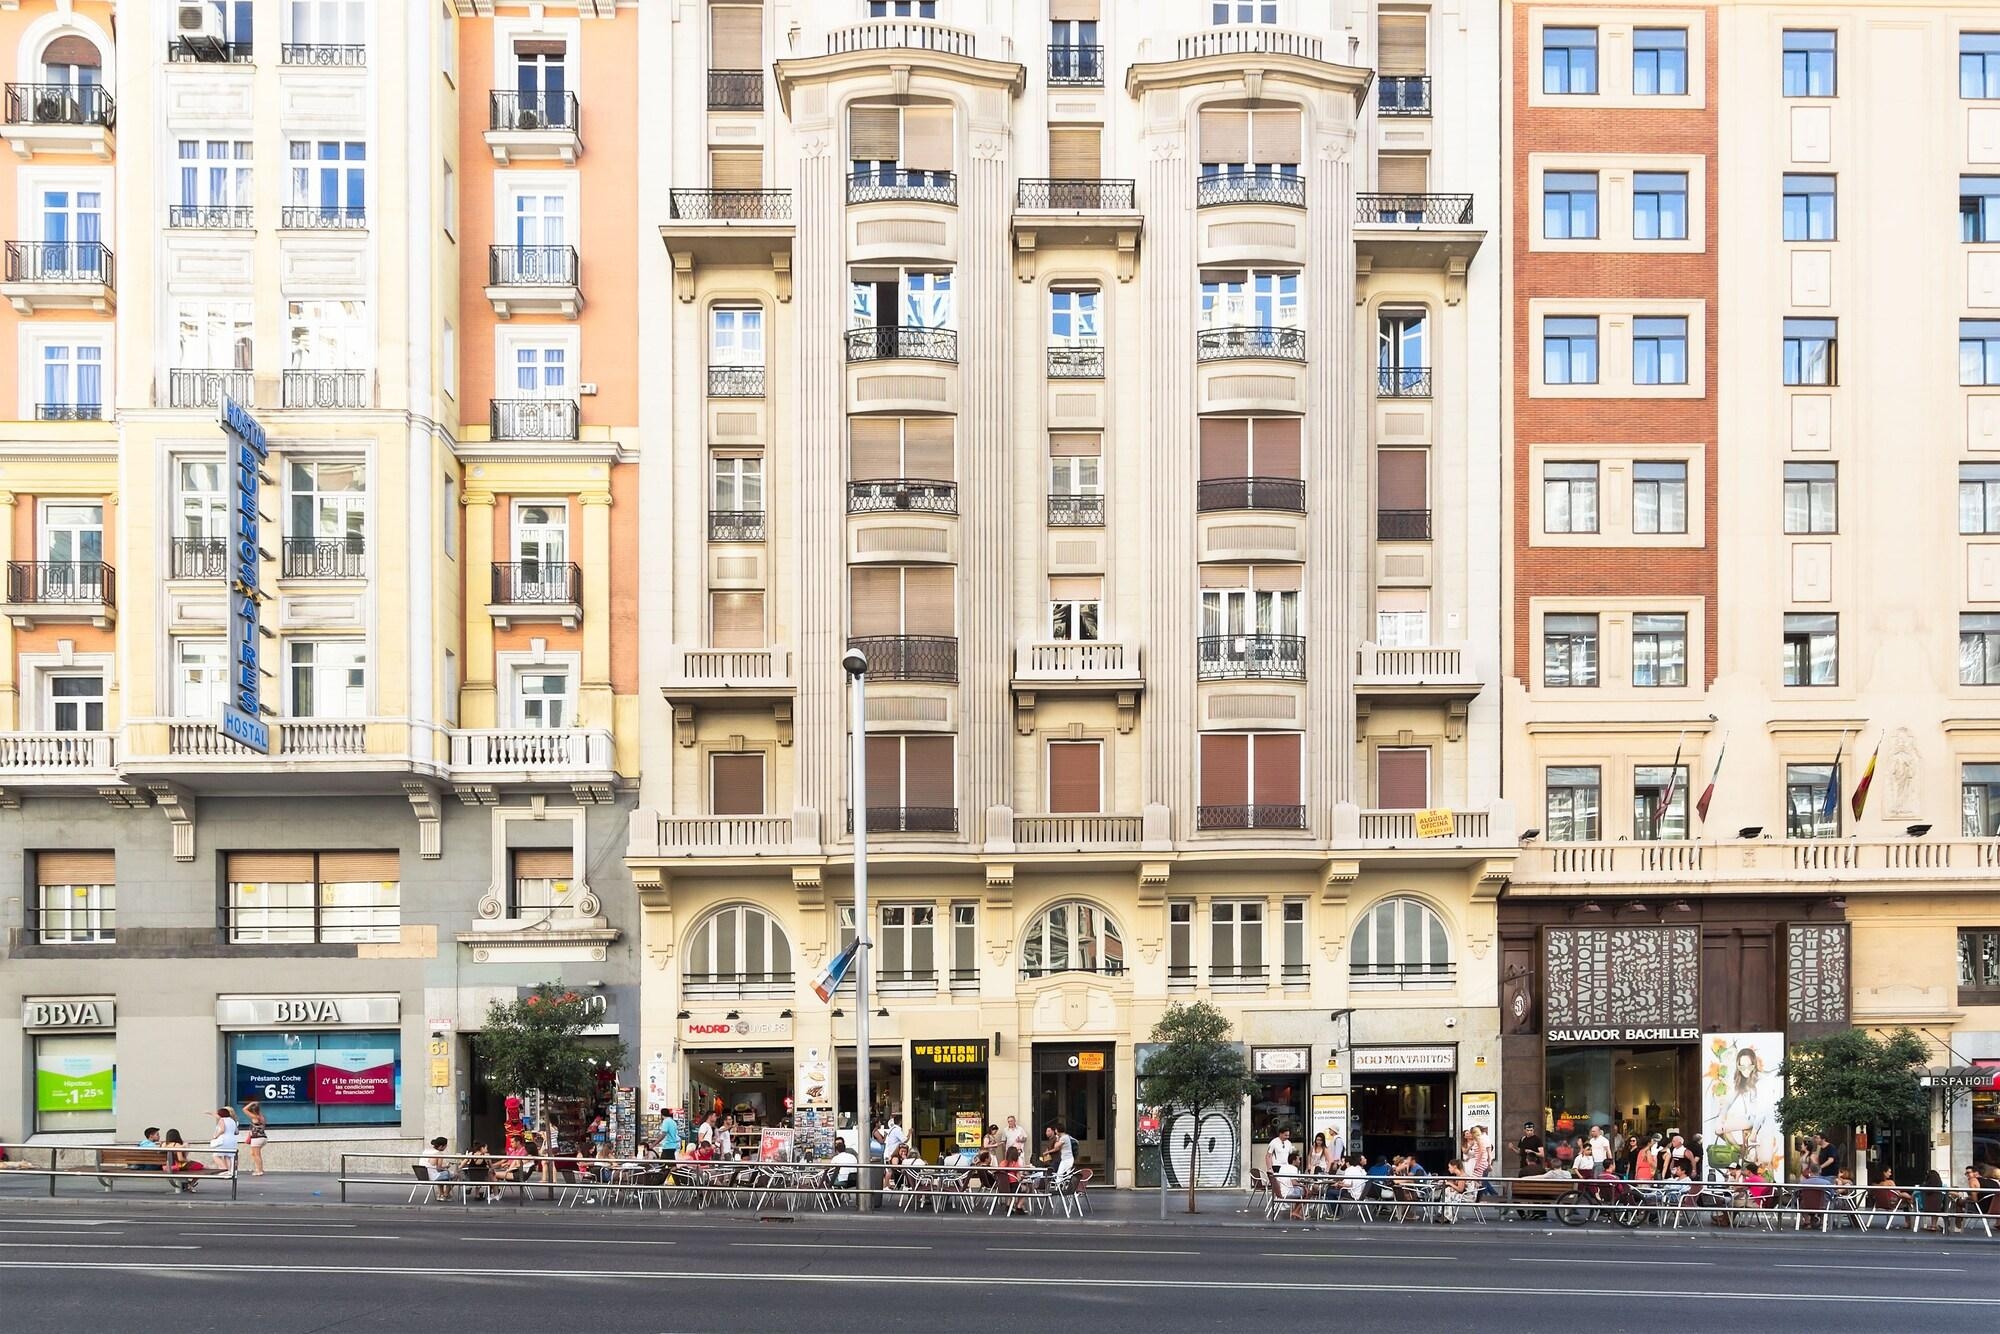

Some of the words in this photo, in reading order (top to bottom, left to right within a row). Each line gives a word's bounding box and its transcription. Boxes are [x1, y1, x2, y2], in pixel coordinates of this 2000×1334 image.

[226, 398, 269, 458] HOSTAL
[239, 445, 257, 588] BUENOS
[239, 598, 258, 714] AIRES
[226, 711, 267, 748] HOSTAL
[1420, 815, 1449, 824] ALQUILA
[1421, 821, 1449, 830] OFICINA
[1577, 931, 1592, 1026] SALVADOR
[1593, 931, 1607, 1026] BACHILLER
[1789, 928, 1803, 1022] SALVADOR
[1805, 928, 1818, 1023] BACHILLER
[33, 1004, 101, 1025] BBVA
[274, 1001, 342, 1022] BBVA
[689, 1025, 730, 1034] MADRID
[1548, 1029, 1620, 1041] SALVADOR
[1625, 1028, 1699, 1040] BACHILLER
[429, 1041, 448, 1055] 61
[915, 1045, 975, 1055] WESTERN
[933, 1054, 975, 1063] UNION
[1384, 1054, 1451, 1064] MONTADITOS
[348, 1077, 388, 1085] mejoramos
[649, 1103, 660, 1111] 49
